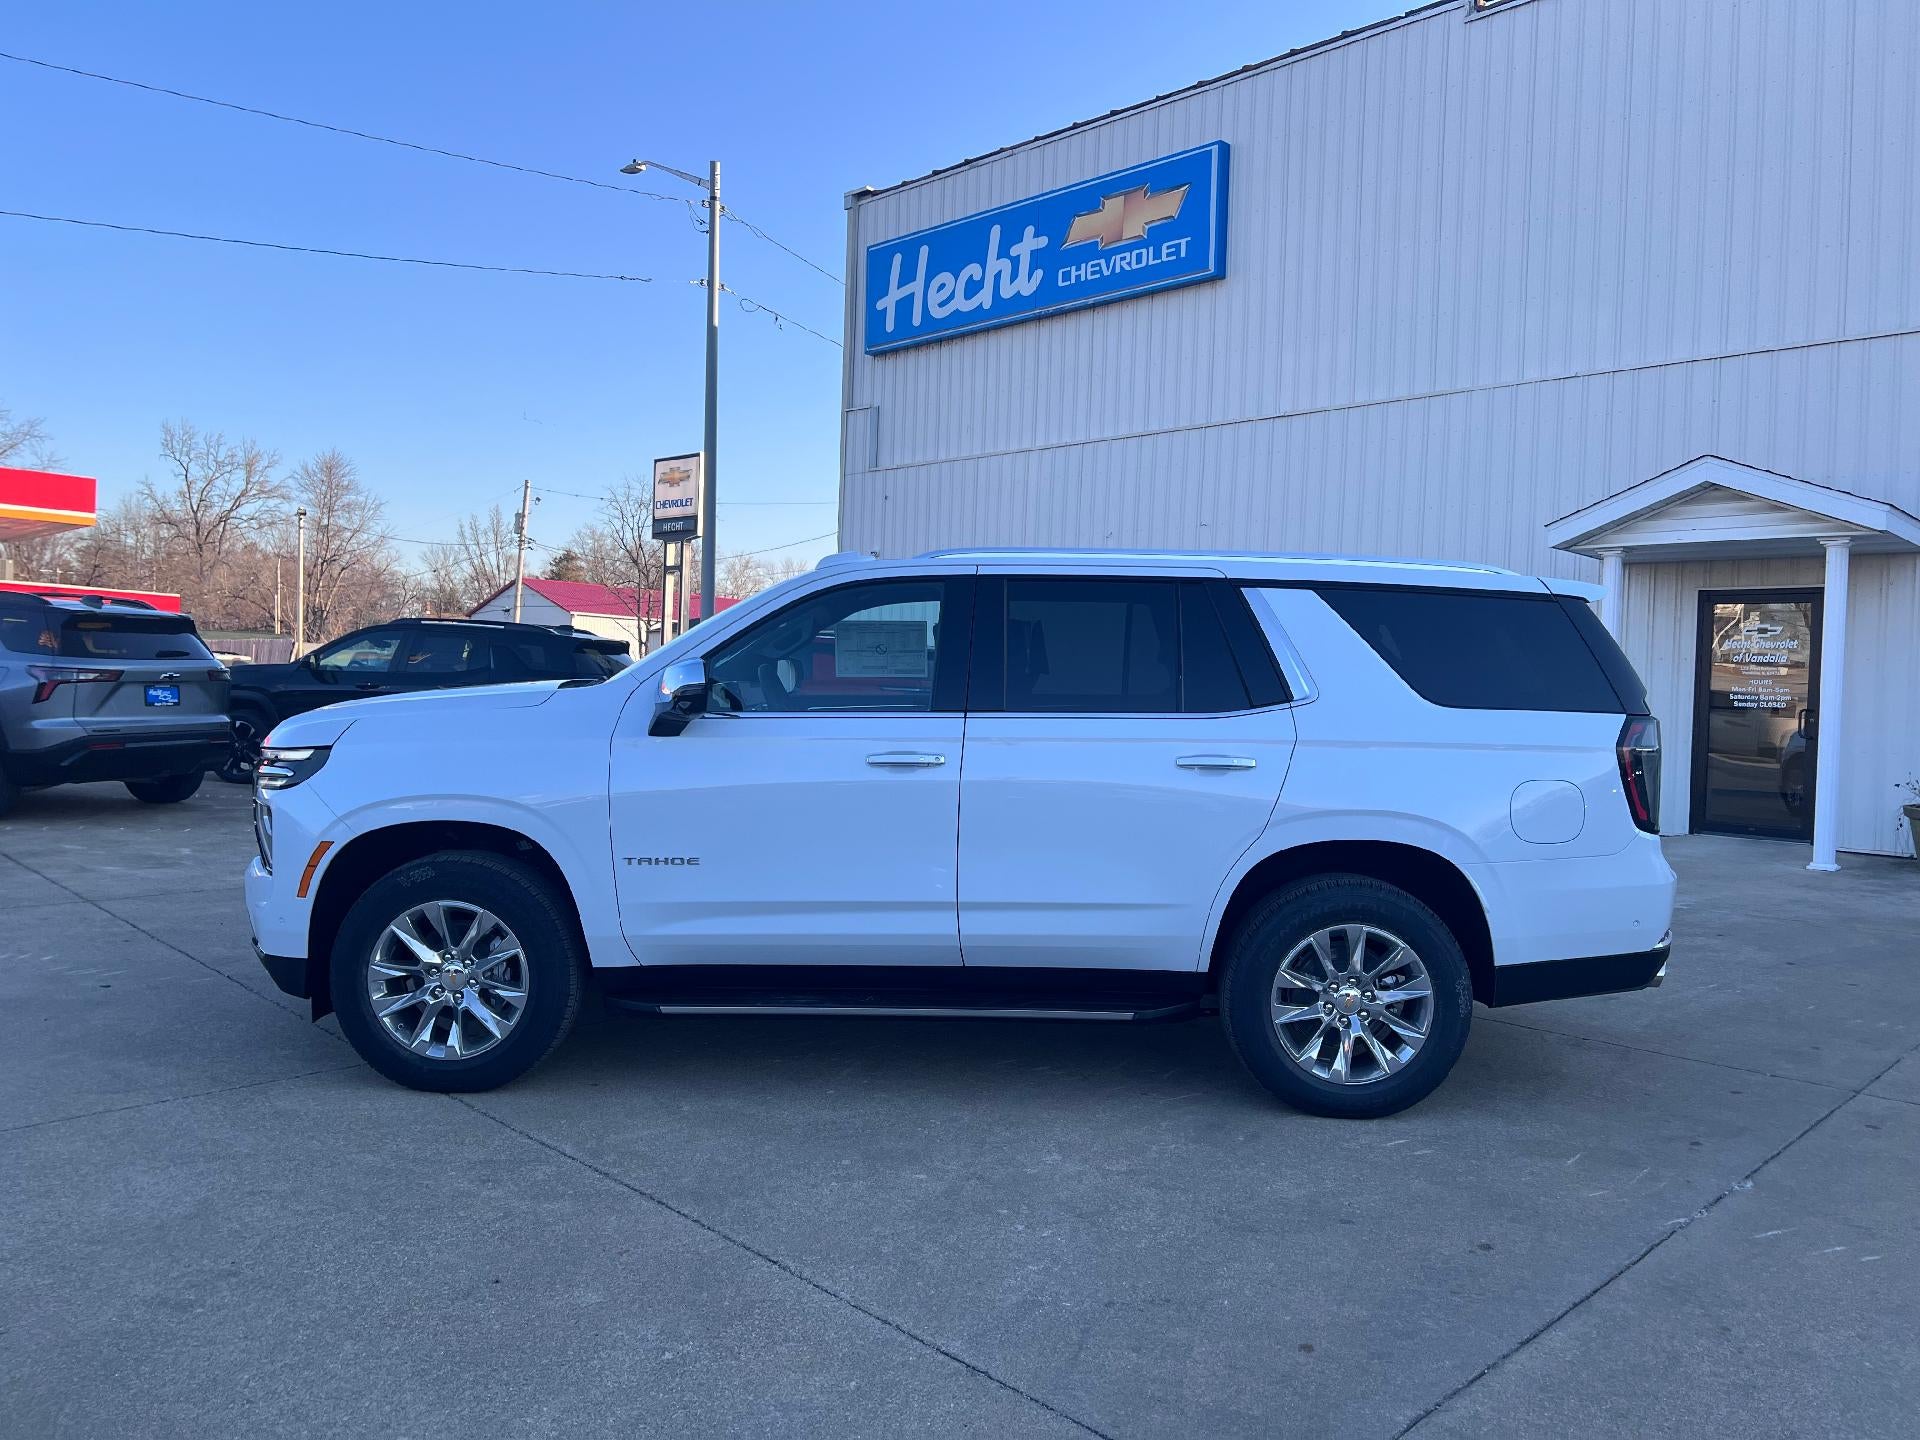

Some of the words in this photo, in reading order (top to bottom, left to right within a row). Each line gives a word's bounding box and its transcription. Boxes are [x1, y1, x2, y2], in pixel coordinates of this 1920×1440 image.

[1057, 236, 1192, 288] CHEVROLET
[875, 224, 1049, 333] Hecht
[656, 498, 693, 509] CHEVROLET
[663, 522, 683, 531] HECHT
[1726, 639, 1751, 649] Hecht
[1753, 639, 1798, 648] Chevrolet
[1733, 652, 1744, 663] of
[1746, 653, 1787, 662] Vandalia
[1729, 693, 1759, 701] Saturday
[1760, 694, 1792, 702] 8am-2pm
[622, 857, 700, 866] TAHOE
